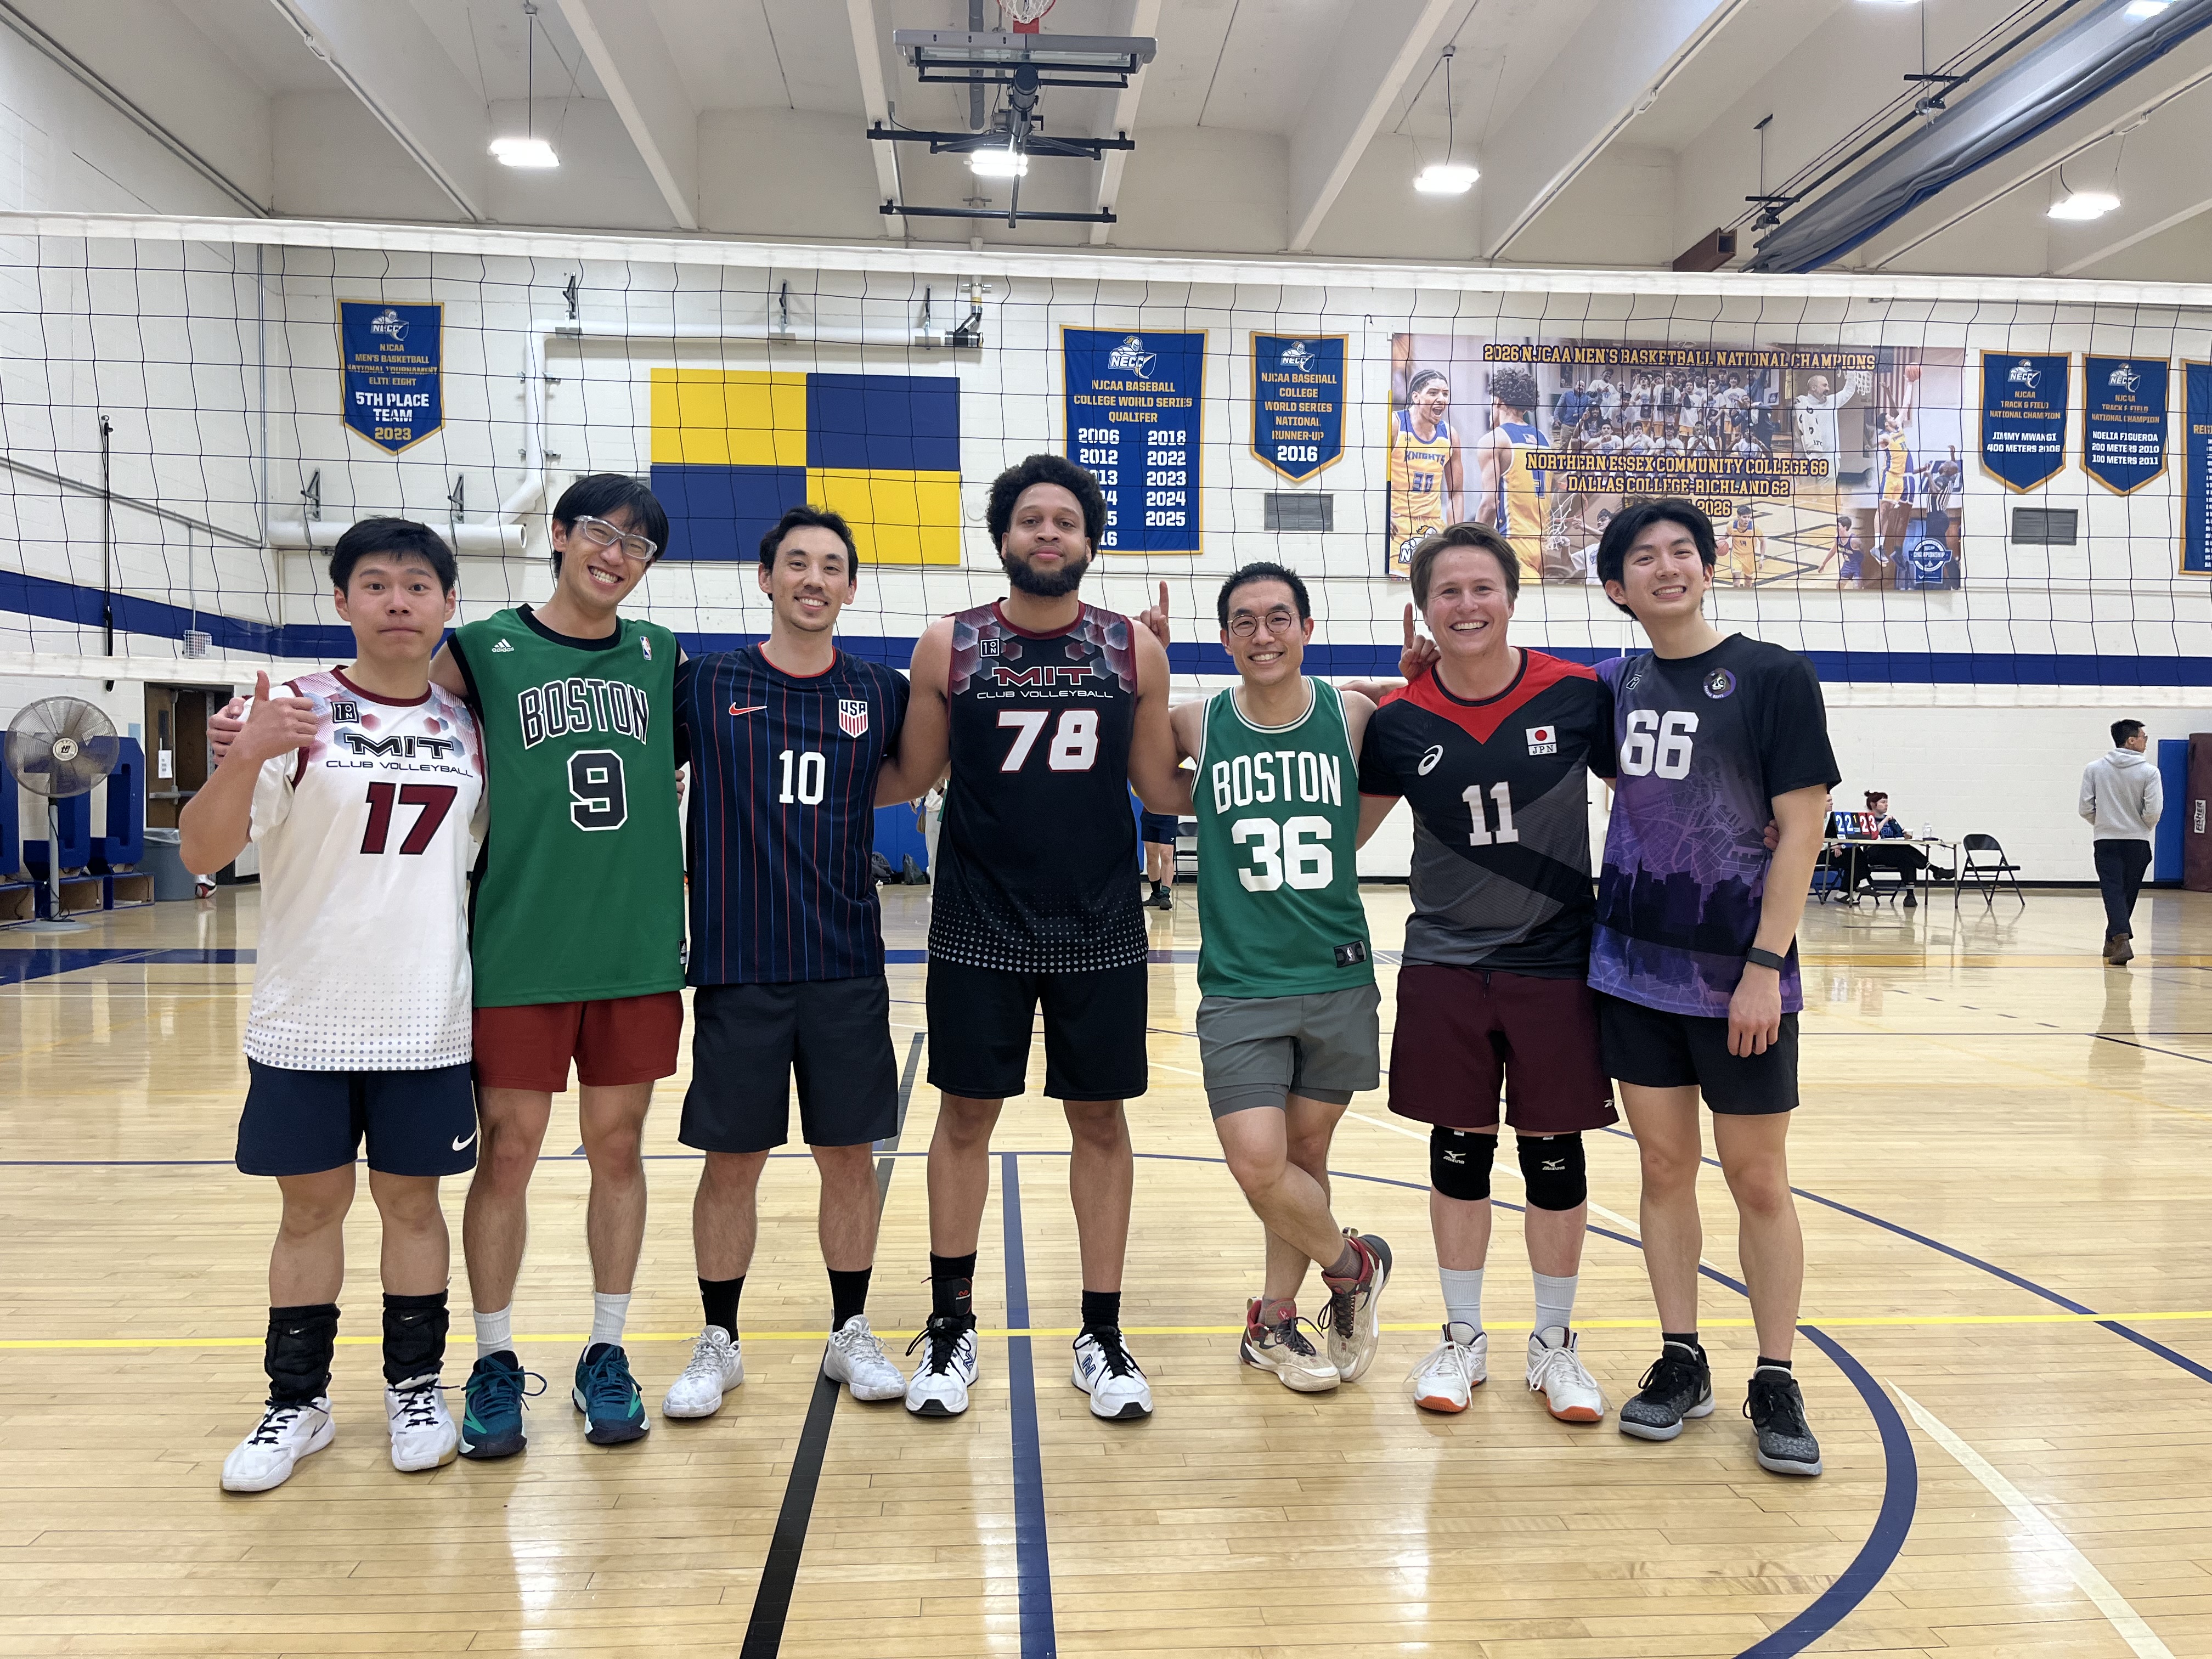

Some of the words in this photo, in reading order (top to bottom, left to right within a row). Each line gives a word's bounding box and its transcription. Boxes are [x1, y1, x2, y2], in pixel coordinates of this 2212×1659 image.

[356, 354, 379, 362] MEN'S
[381, 355, 430, 363] BASKETBALL
[1111, 356, 1144, 368] NECC
[1484, 345, 1519, 362] 2026
[1521, 346, 1571, 363] NJCAA
[1574, 347, 1618, 364] MEN'S
[1621, 348, 1713, 366] BASKETBALL
[1716, 351, 1788, 368] NATIONAL
[1791, 352, 1876, 370] CHAMPIONS
[347, 364, 385, 373] NATIONAL
[386, 366, 438, 375] TOURNAMENT
[393, 377, 416, 386] EIGHT
[1092, 380, 1123, 391] NJCAA
[1126, 381, 1175, 392] BASEBALL
[1261, 373, 1290, 383] NJCAA
[1292, 374, 1337, 384] BASEBALL
[356, 392, 383, 406] 5TH
[387, 393, 429, 407] PLACE
[1279, 388, 1318, 398] COLLEGE
[1074, 396, 1116, 405] COLLEGE
[1119, 397, 1154, 407] WORLD
[1156, 398, 1193, 407] SERIES
[1265, 402, 1296, 411] WORLD
[1299, 403, 1332, 413] SERIES
[373, 408, 413, 422] TEAM
[1109, 411, 1158, 423] QUALIFER
[1990, 410, 2022, 419] NATIONAL
[2023, 411, 2061, 420] CHAMPION
[2092, 413, 2121, 422] NATIONAL
[2124, 415, 2160, 424] CHAMPION
[375, 427, 411, 441] 2023
[1078, 428, 1119, 444] 2006
[1148, 430, 1186, 445] 2018
[1272, 431, 1324, 441] RUNNER-UP
[1993, 432, 2020, 441] JIMMY
[2021, 433, 2057, 442] MWANGI
[2092, 431, 2119, 441] NOELIA
[2120, 432, 2158, 442] FIGUEROA
[1277, 445, 1318, 462] 2016
[1987, 444, 2004, 452] 400
[2005, 444, 2037, 453] METERS
[2092, 443, 2105, 451] 200
[2107, 444, 2137, 452] METERS
[2139, 445, 2160, 454] 2010
[1080, 448, 1118, 465] 2012
[1147, 451, 1186, 466] 2022
[1404, 450, 1446, 466] KNIGHTS
[1527, 453, 1606, 471] NORTHERN
[1609, 455, 1655, 472] ESSEX
[1656, 456, 1743, 474] COMMUNITY
[1746, 459, 1808, 476] COLLEGE
[1810, 460, 1828, 476] 68
[2092, 454, 2105, 463] 100
[2107, 455, 2137, 465] METERS
[2139, 456, 2159, 465] 2011
[1147, 471, 1186, 486] 2023
[1568, 476, 1624, 493] DALLAS
[1626, 477, 1770, 495] COLLEGE-RICHLAND
[1771, 481, 1789, 495] 62
[1146, 491, 1186, 506] 2024
[1146, 511, 1186, 527] 2025
[992, 666, 1094, 687] MIT
[977, 691, 1015, 699] CLUB
[1020, 690, 1114, 698] VOLLEYBALL
[518, 678, 650, 751] BOSTON
[840, 701, 866, 716] USA
[343, 733, 454, 759] MIT
[996, 708, 1101, 774] 78
[1620, 709, 1700, 780] 66
[1532, 745, 1554, 754] JPN
[380, 762, 473, 777] VOLLEYBALL
[779, 750, 826, 805] 10
[1212, 751, 1342, 815] BOSTON
[567, 749, 628, 831] 9
[360, 781, 458, 855] 17
[1462, 781, 1519, 846] 11
[1836, 815, 1854, 832] 22
[1860, 815, 1877, 832] 23
[1231, 815, 1333, 893] 36
